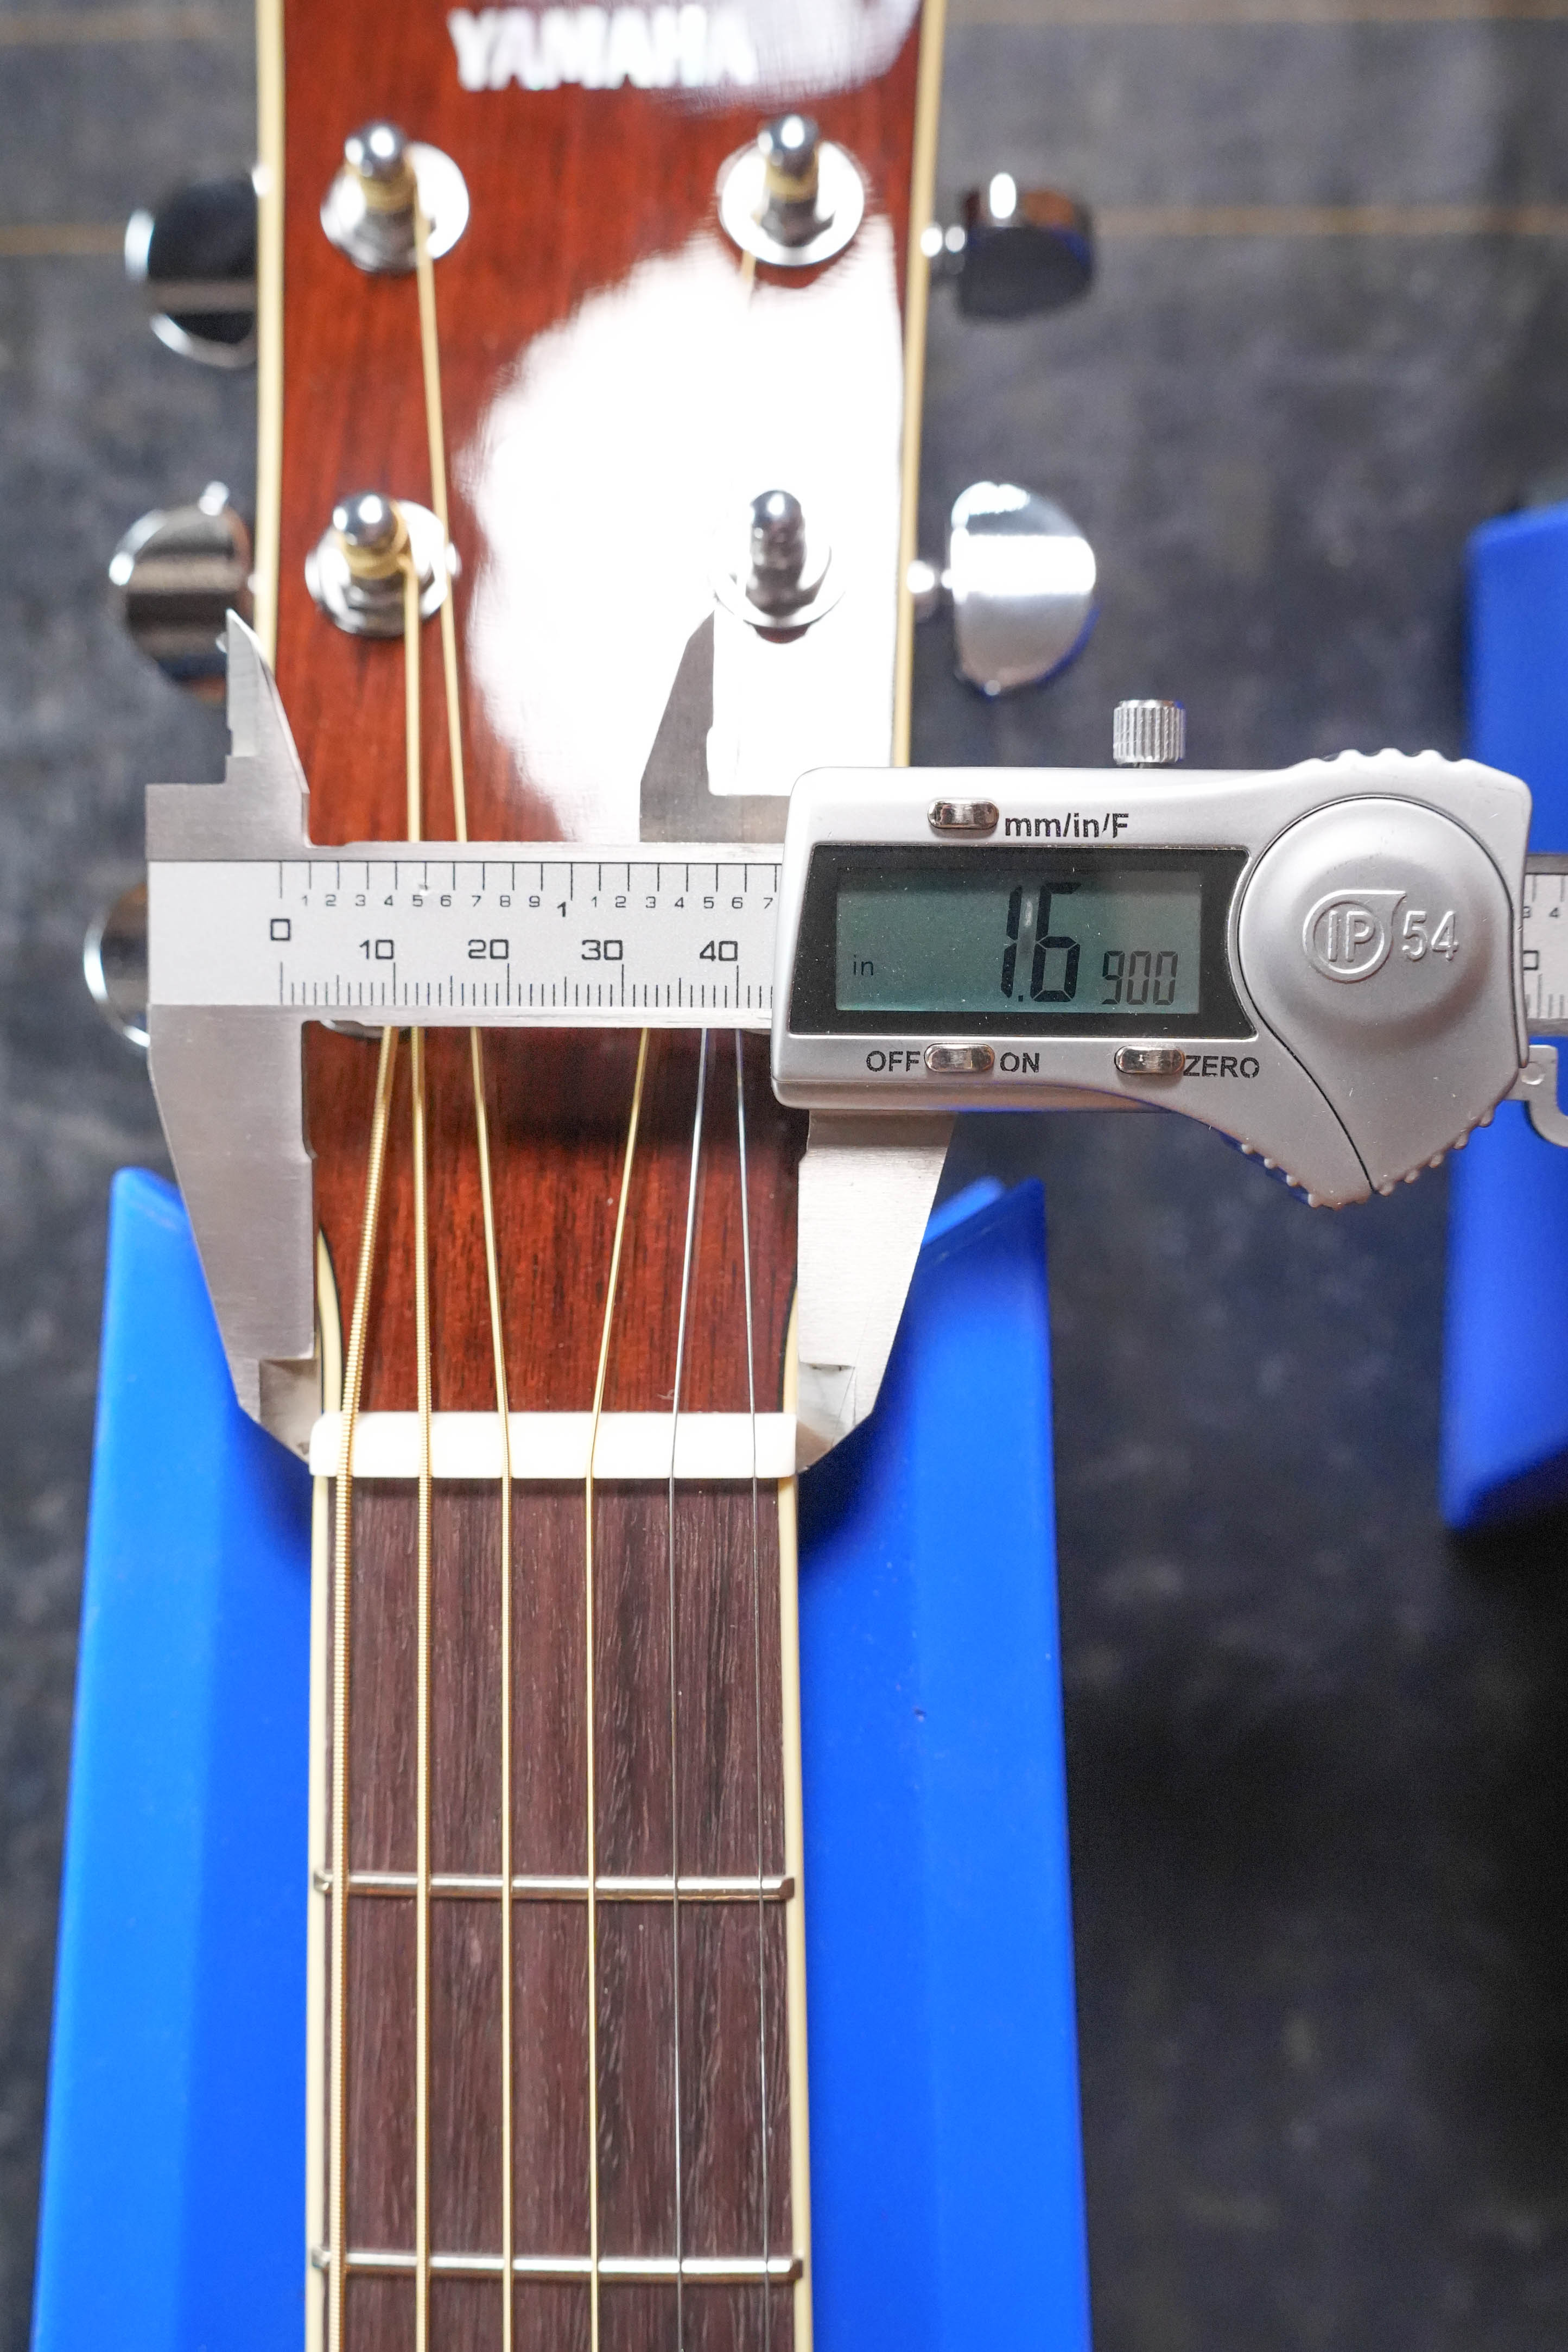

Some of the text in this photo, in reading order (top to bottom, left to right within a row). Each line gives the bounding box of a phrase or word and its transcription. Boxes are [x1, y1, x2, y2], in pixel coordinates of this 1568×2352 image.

[447, 5, 757, 92] YAMAHA
[1005, 813, 1129, 838] mm/in/F
[302, 895, 773, 917] 1 2 3 4 5 6 7 8 9 1 1 2 3 4 5 6 7
[1548, 907, 1559, 918] 4
[270, 918, 291, 942] 0
[1328, 910, 1459, 962] IP 54
[359, 939, 738, 961] 10 20 30 40
[853, 954, 874, 976] in
[866, 1050, 1259, 1079] OFF ON ZERO
